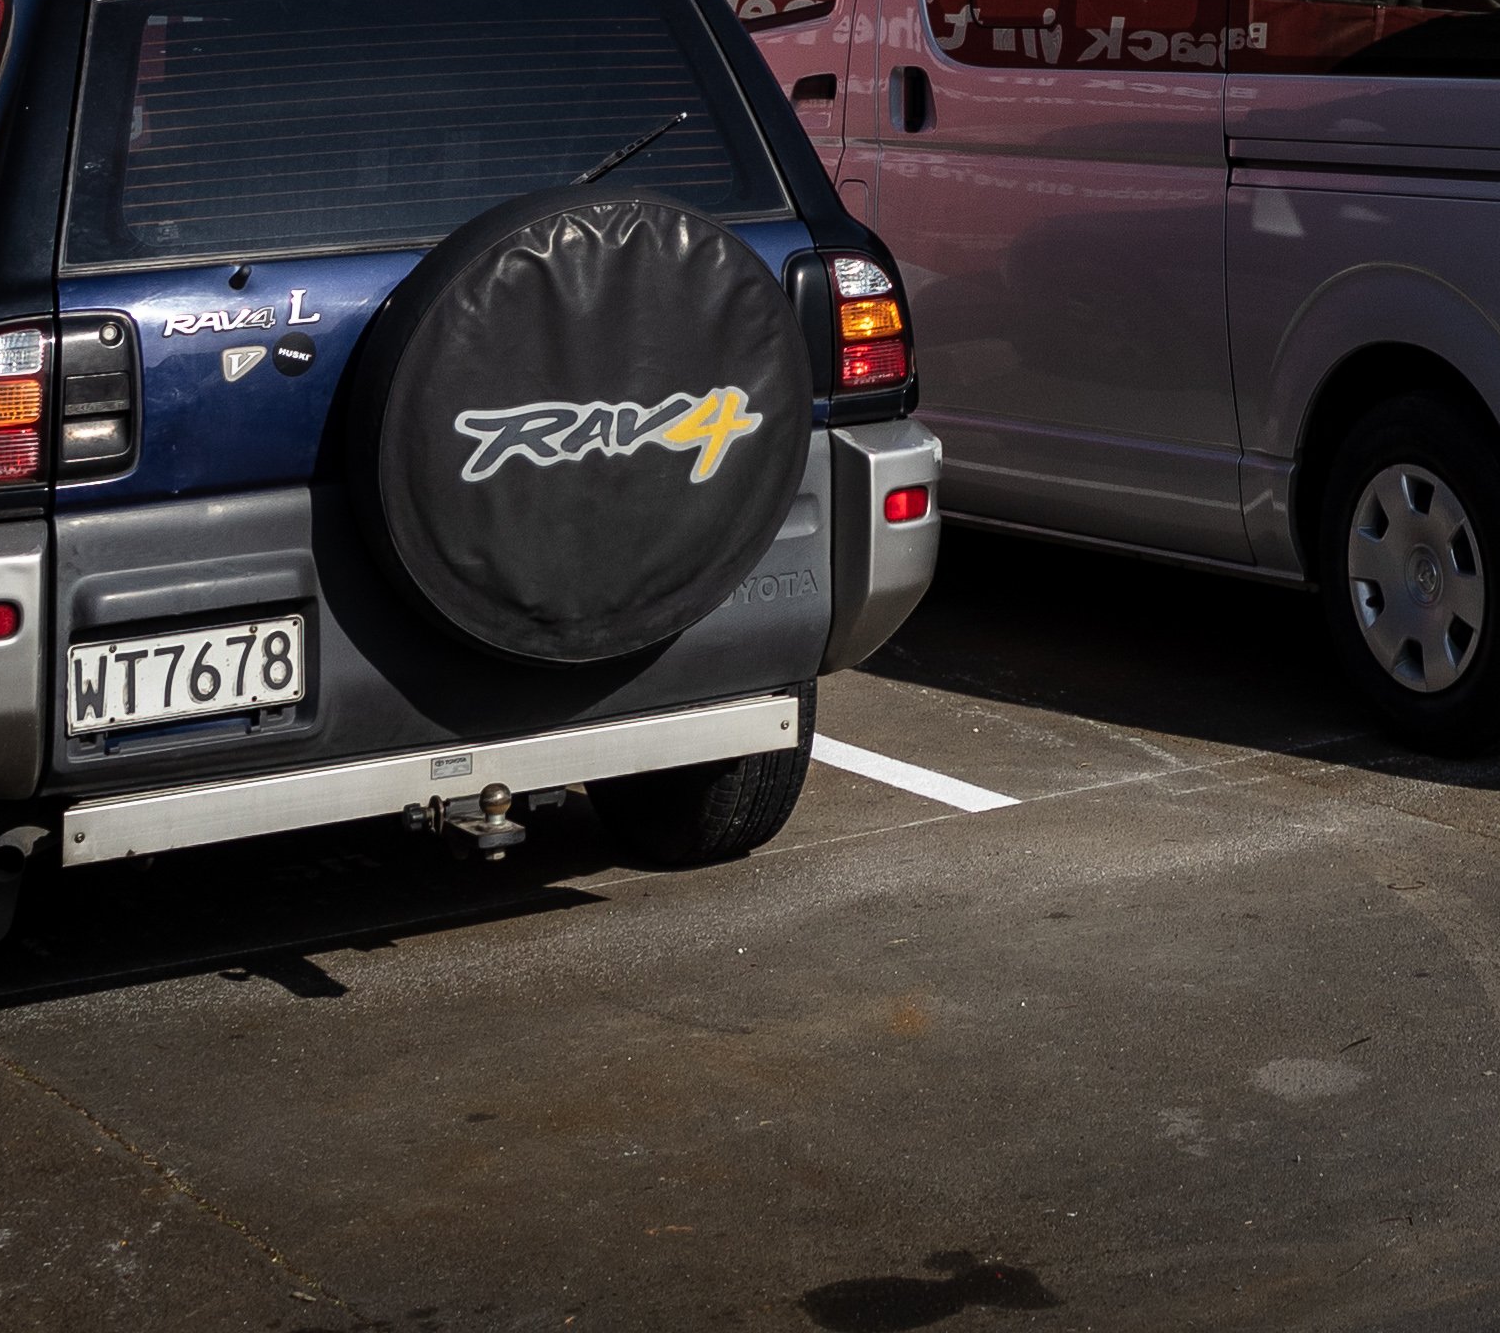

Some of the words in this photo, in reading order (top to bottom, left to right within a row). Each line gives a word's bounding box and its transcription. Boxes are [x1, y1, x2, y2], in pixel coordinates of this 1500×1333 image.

[163, 306, 278, 338] RAV4
[286, 288, 322, 326] L
[453, 385, 763, 485] RAV4
[73, 629, 295, 722] WT7678
